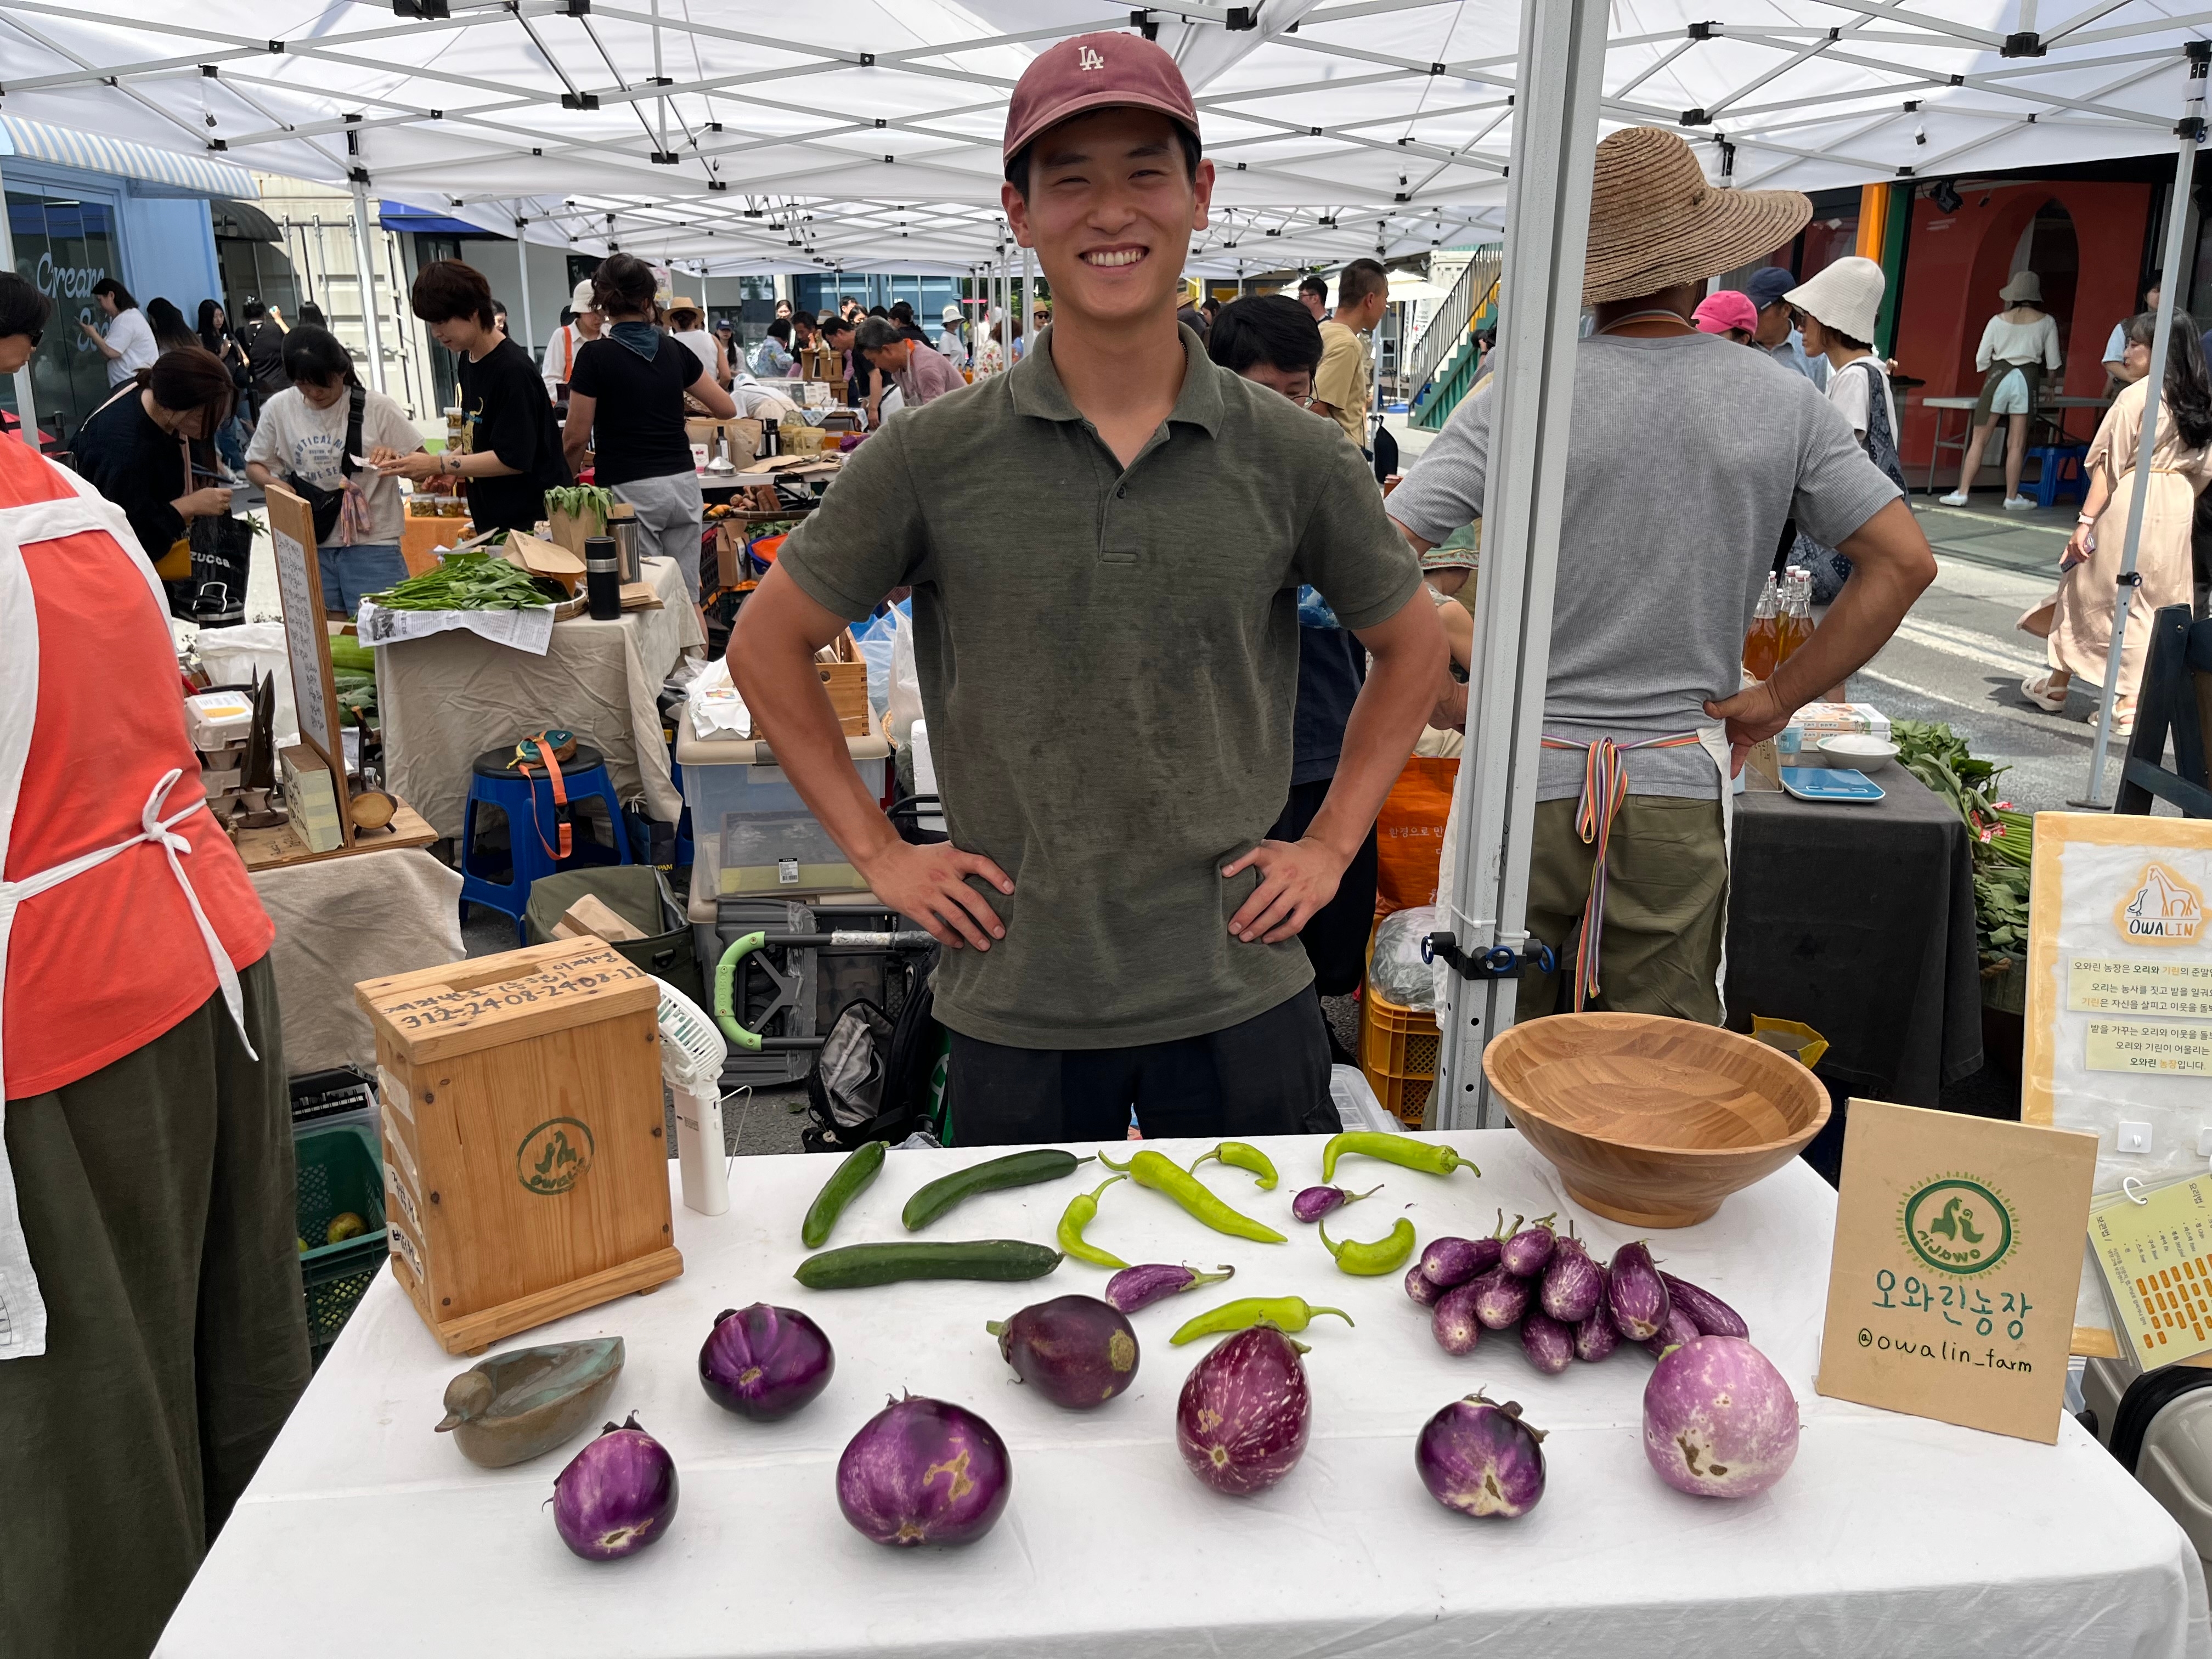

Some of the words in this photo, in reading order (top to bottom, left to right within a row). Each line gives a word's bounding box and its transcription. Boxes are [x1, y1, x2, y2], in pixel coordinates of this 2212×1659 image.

[1078, 46, 1104, 71] LA
[37, 252, 105, 299] Cream
[295, 435, 331, 465] NAUTICAL
[2129, 919, 2193, 936] OWALIN
[2073, 962, 2101, 972] 오와린
[2104, 963, 2130, 973] 농장은
[2133, 965, 2159, 974] 오리와
[2163, 966, 2189, 976] 기린의
[2091, 983, 2118, 993] 오리는
[2121, 985, 2147, 995] 농사를
[2150, 986, 2168, 995] 짓고
[2171, 987, 2188, 996] 밭을
[2081, 997, 2109, 1008] 기린은
[2112, 999, 2138, 1009] 자신을
[2141, 1001, 2168, 1010] 살피고
[2170, 1002, 2197, 1012] 이웃을
[2091, 1024, 2109, 1034] 밭을
[2112, 1025, 2138, 1036] 가꾸는
[2141, 1028, 2168, 1037] 오리와
[2170, 1029, 2197, 1039] 이웃을
[2115, 1041, 2142, 1051] 오리와
[2145, 1043, 2172, 1053] 기린이
[2174, 1045, 2210, 1056] 어울리는
[2130, 1057, 2157, 1068] 오와린
[2160, 1059, 2206, 1070] 농장입니다.
[2189, 1182, 2203, 1204] 요리법
[2096, 1216, 2110, 1237] 보관법
[2148, 1239, 2155, 1249] 구이
[1872, 1269, 2033, 1340] 오와린농장
[1858, 1328, 2032, 1373] @owalin_farm
